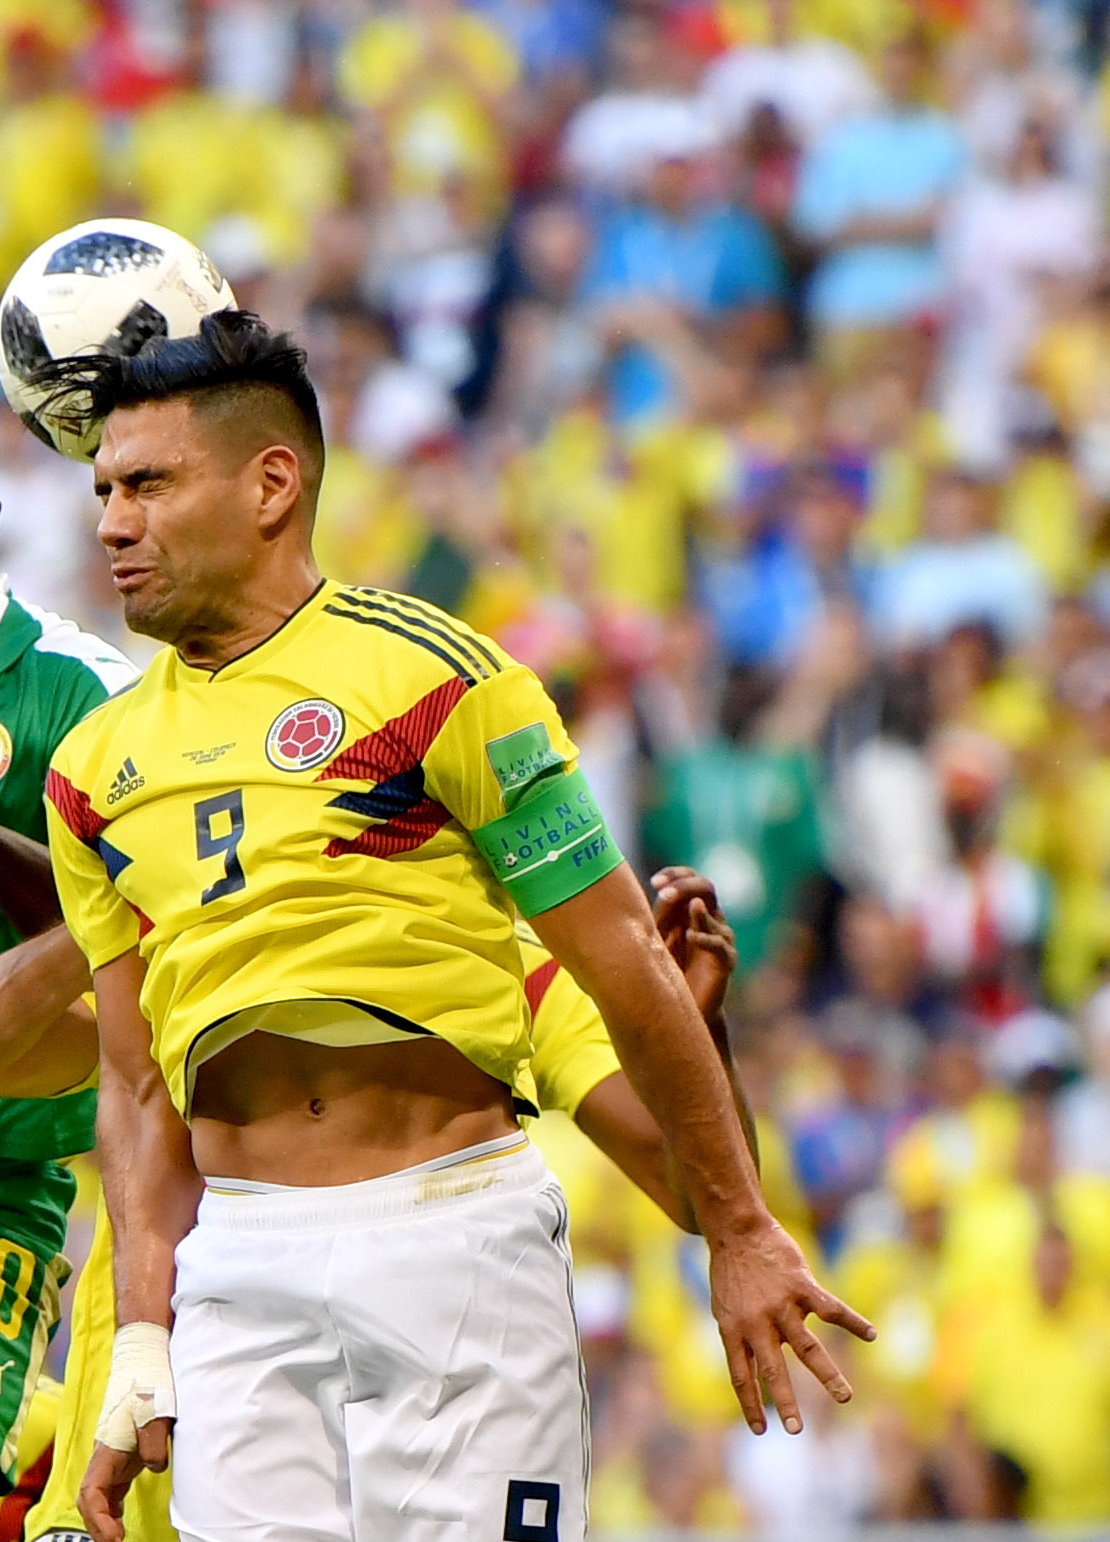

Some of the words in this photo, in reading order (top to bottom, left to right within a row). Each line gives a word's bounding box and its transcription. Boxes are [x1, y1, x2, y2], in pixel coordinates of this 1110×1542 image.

[106, 775, 145, 805] adidas
[194, 787, 246, 906] 9
[572, 836, 608, 867] FIFA
